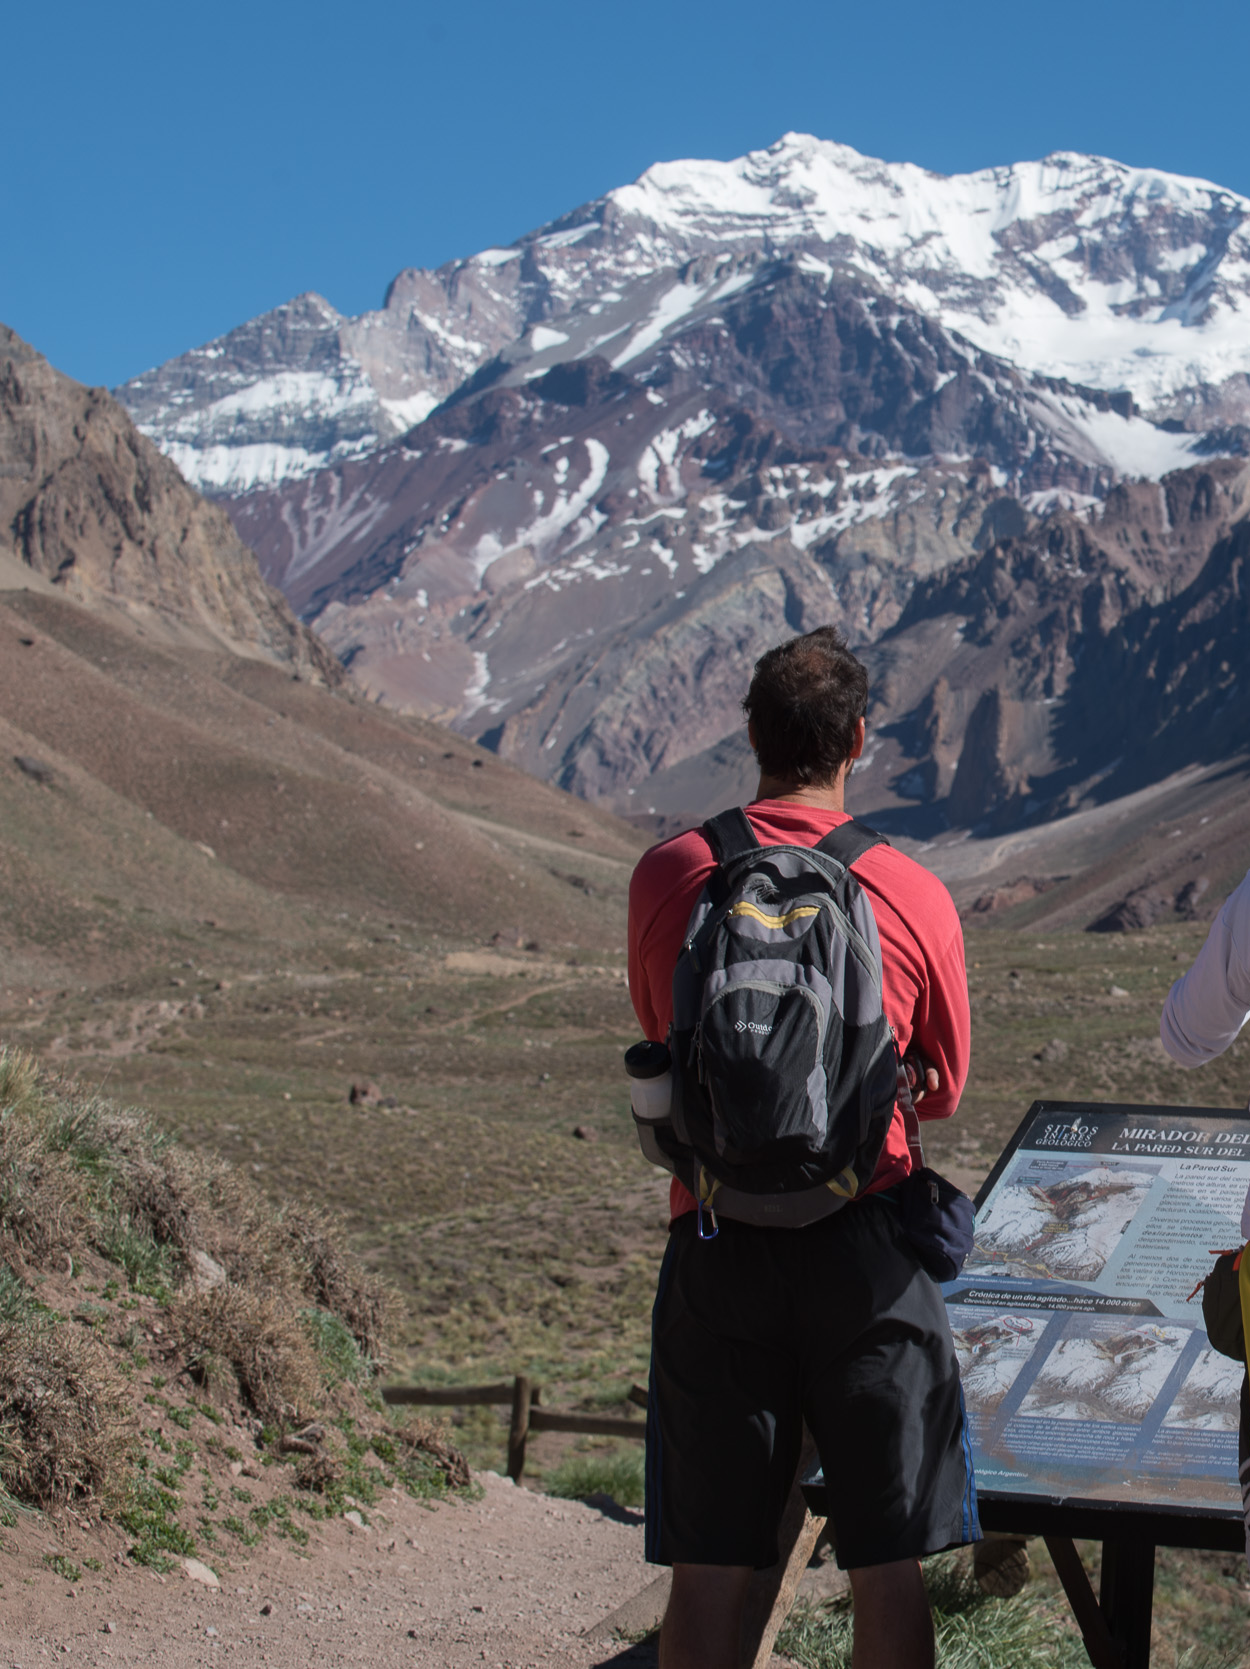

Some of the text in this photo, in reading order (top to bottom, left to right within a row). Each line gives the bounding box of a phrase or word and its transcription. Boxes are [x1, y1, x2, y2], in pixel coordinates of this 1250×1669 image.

[747, 1021, 772, 1031] Outdo
[1044, 1124, 1098, 1135] SITOS
[1119, 1128, 1210, 1142] MIRADOR
[1111, 1142, 1246, 1157] LA PARED SUR DEL
[1191, 1164, 1220, 1172] Pared
[969, 1290, 1000, 1299] Crónica
[1012, 1292, 1023, 1300] un
[1095, 1298, 1120, 1306] 14.000
